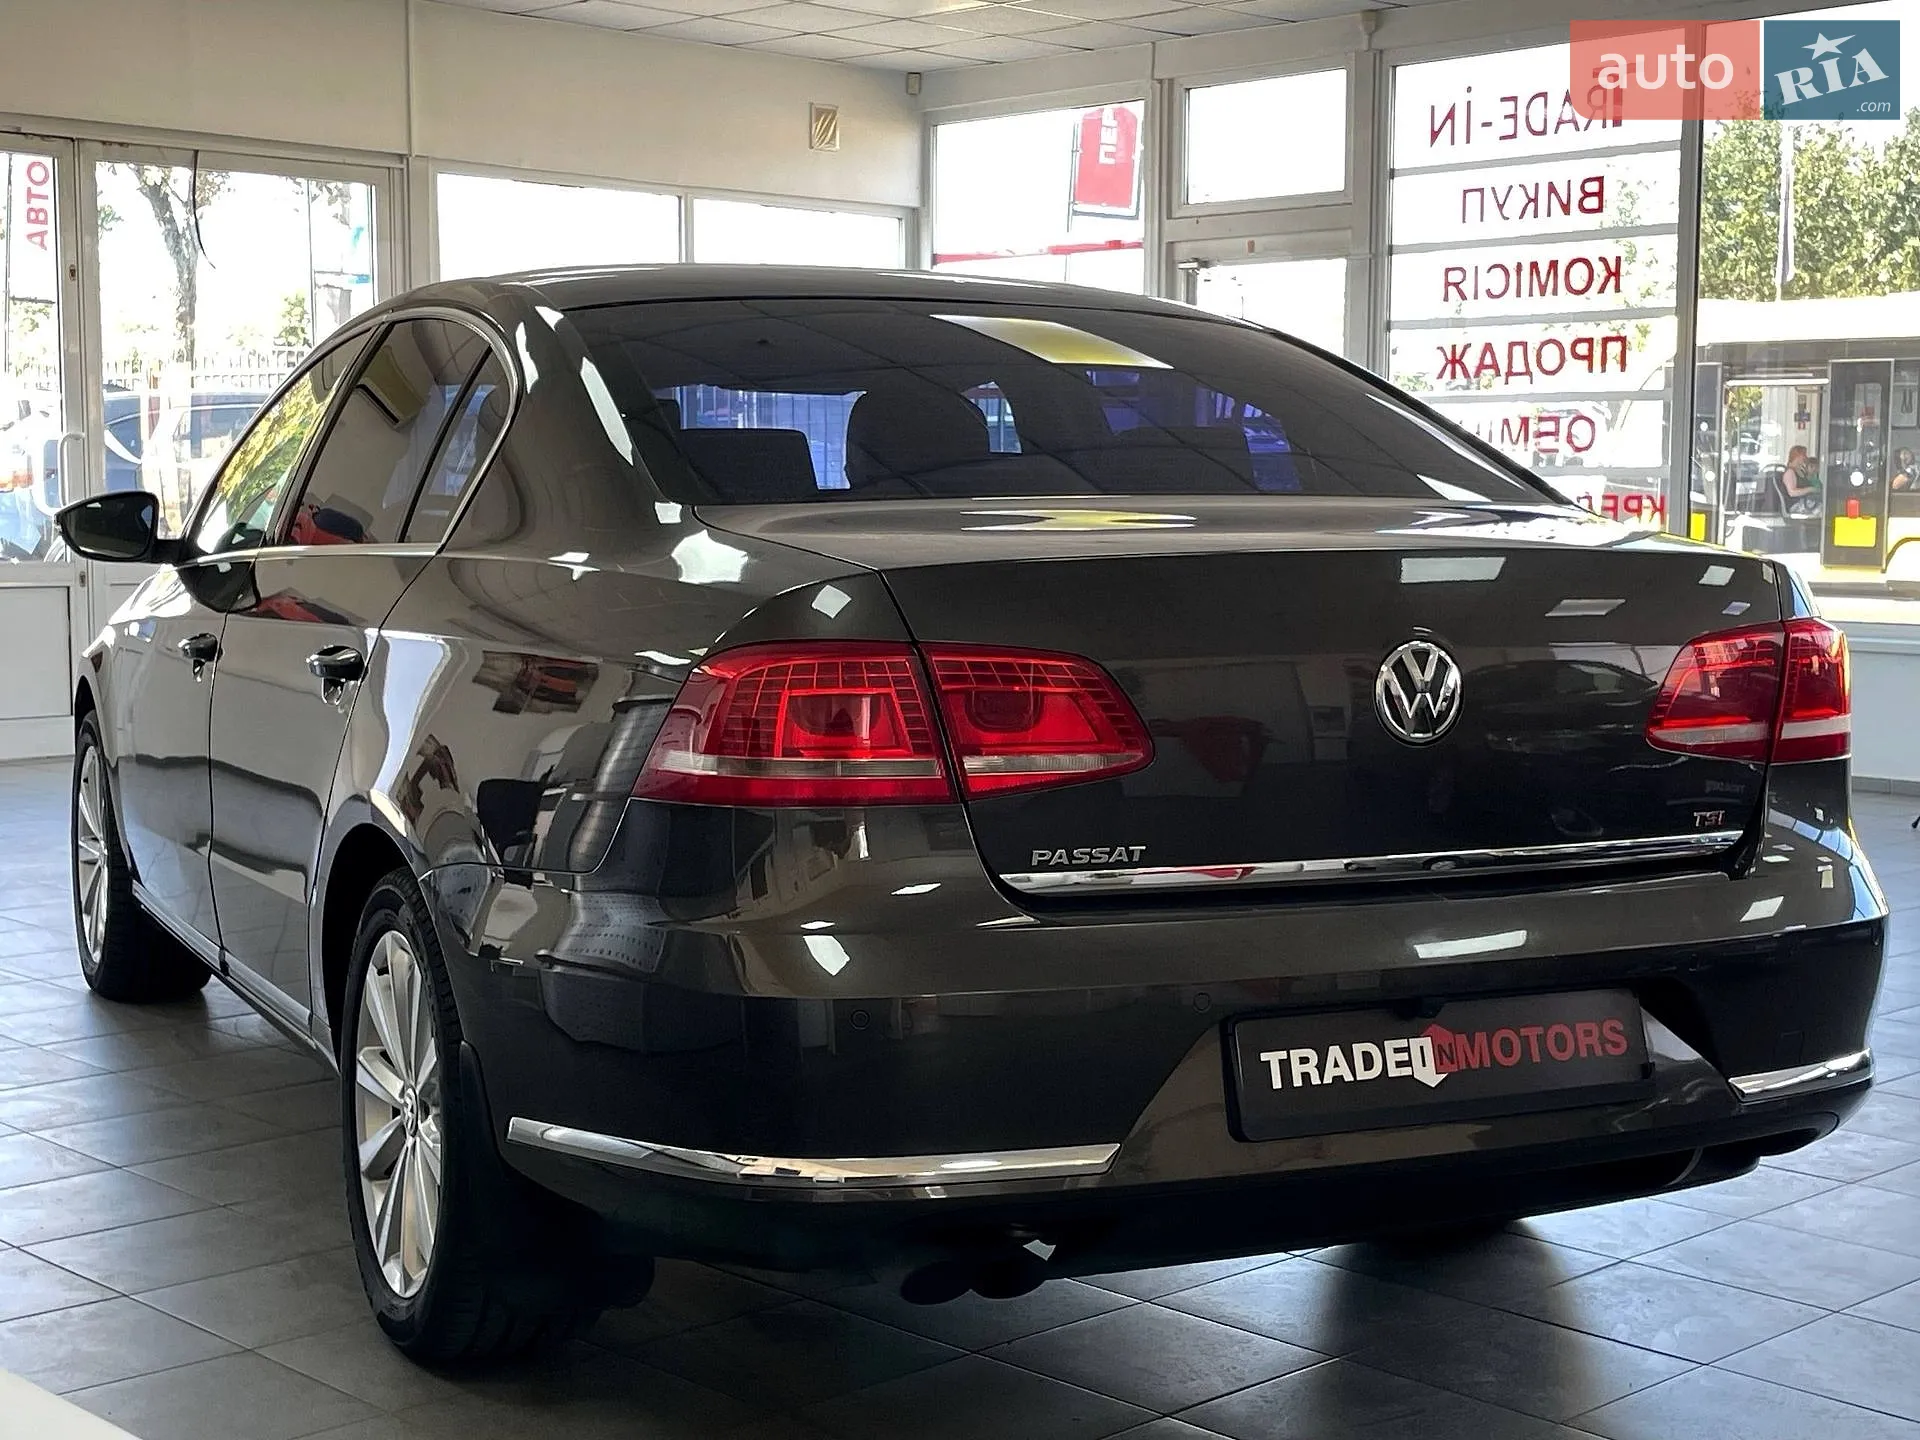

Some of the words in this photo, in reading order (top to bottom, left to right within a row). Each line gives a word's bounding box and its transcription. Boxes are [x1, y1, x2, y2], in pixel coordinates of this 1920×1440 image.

[26, 161, 50, 250] АВТО
[1693, 810, 1725, 827] TSI
[1031, 846, 1146, 866] PASSAT
